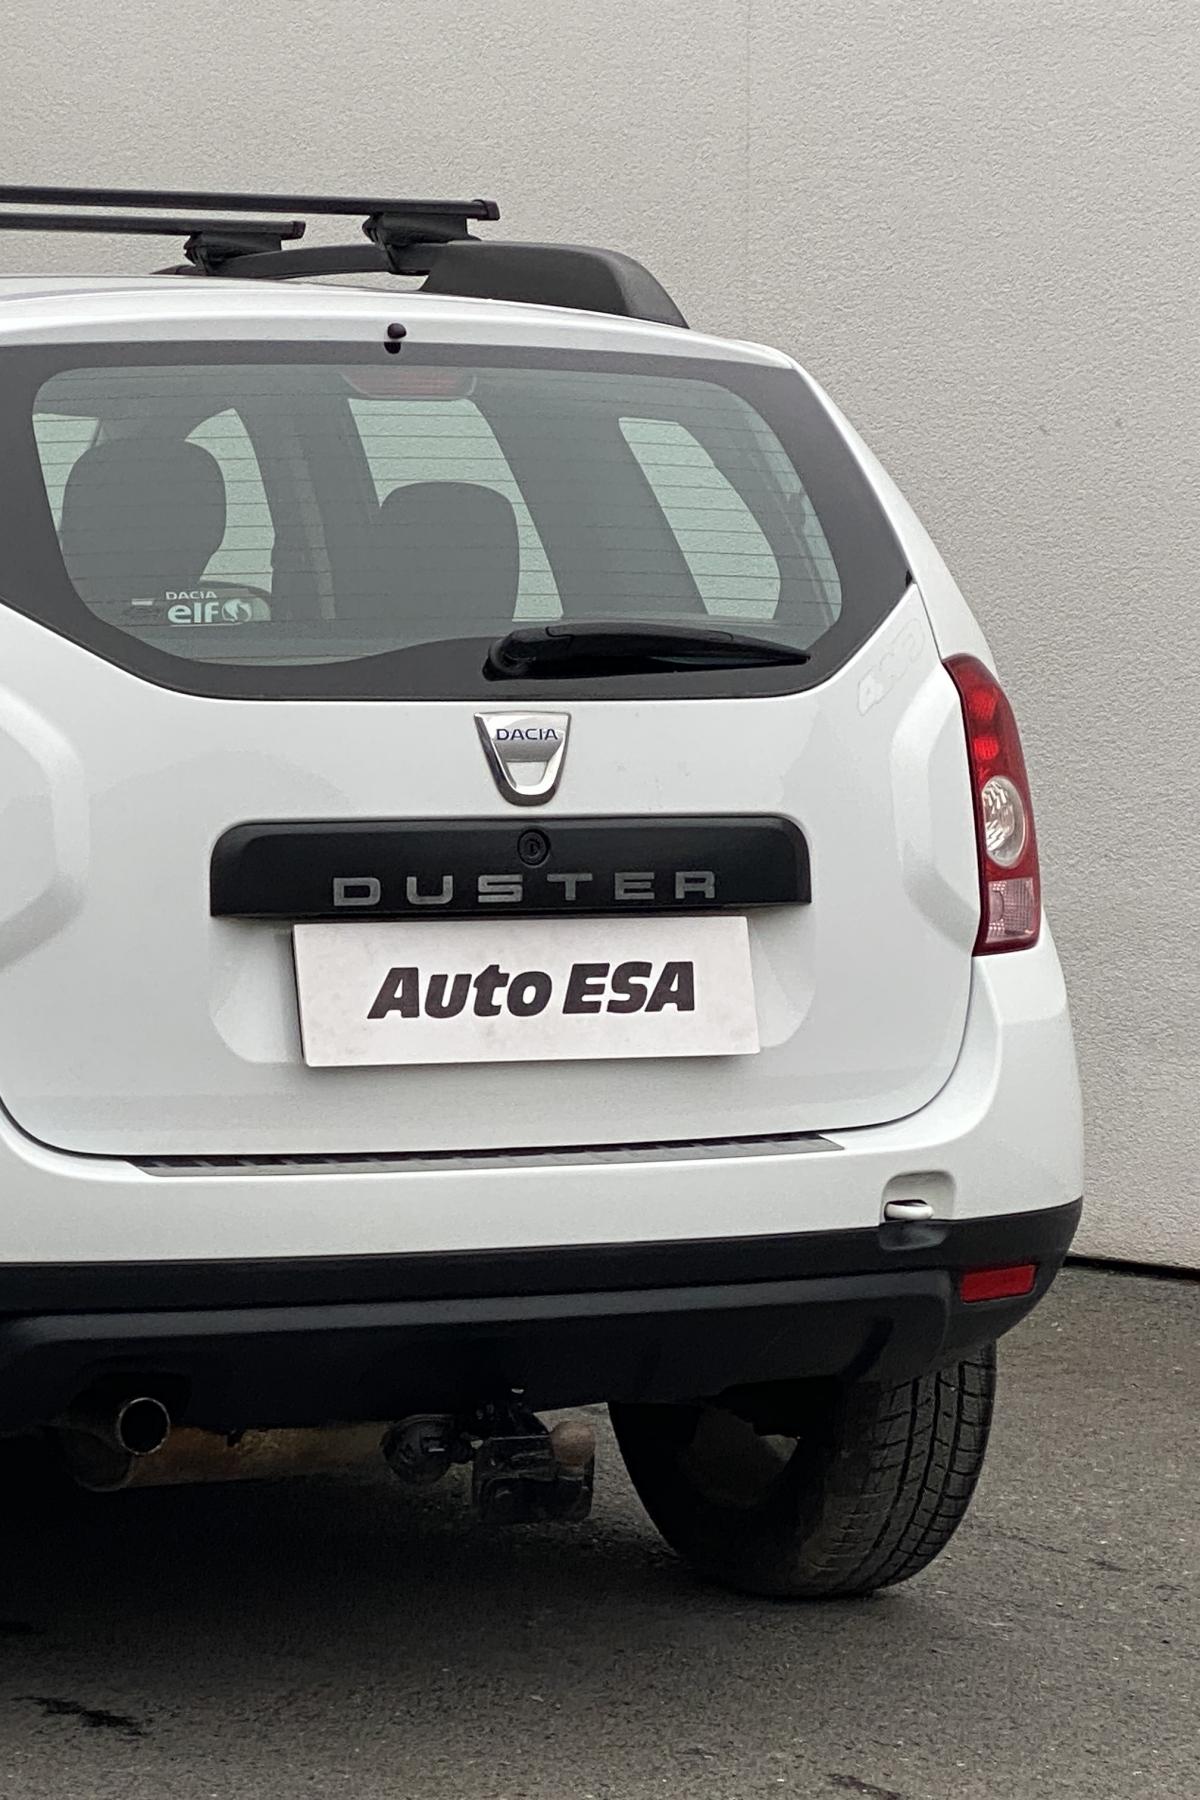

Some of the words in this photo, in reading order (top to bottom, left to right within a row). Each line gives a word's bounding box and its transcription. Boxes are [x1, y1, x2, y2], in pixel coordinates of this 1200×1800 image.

[165, 591, 217, 600] DACIA
[167, 602, 219, 624] elf
[496, 728, 558, 740] DACIA
[332, 870, 716, 906] DUSTER
[367, 964, 552, 1019] Auto
[562, 961, 695, 1014] ESA
